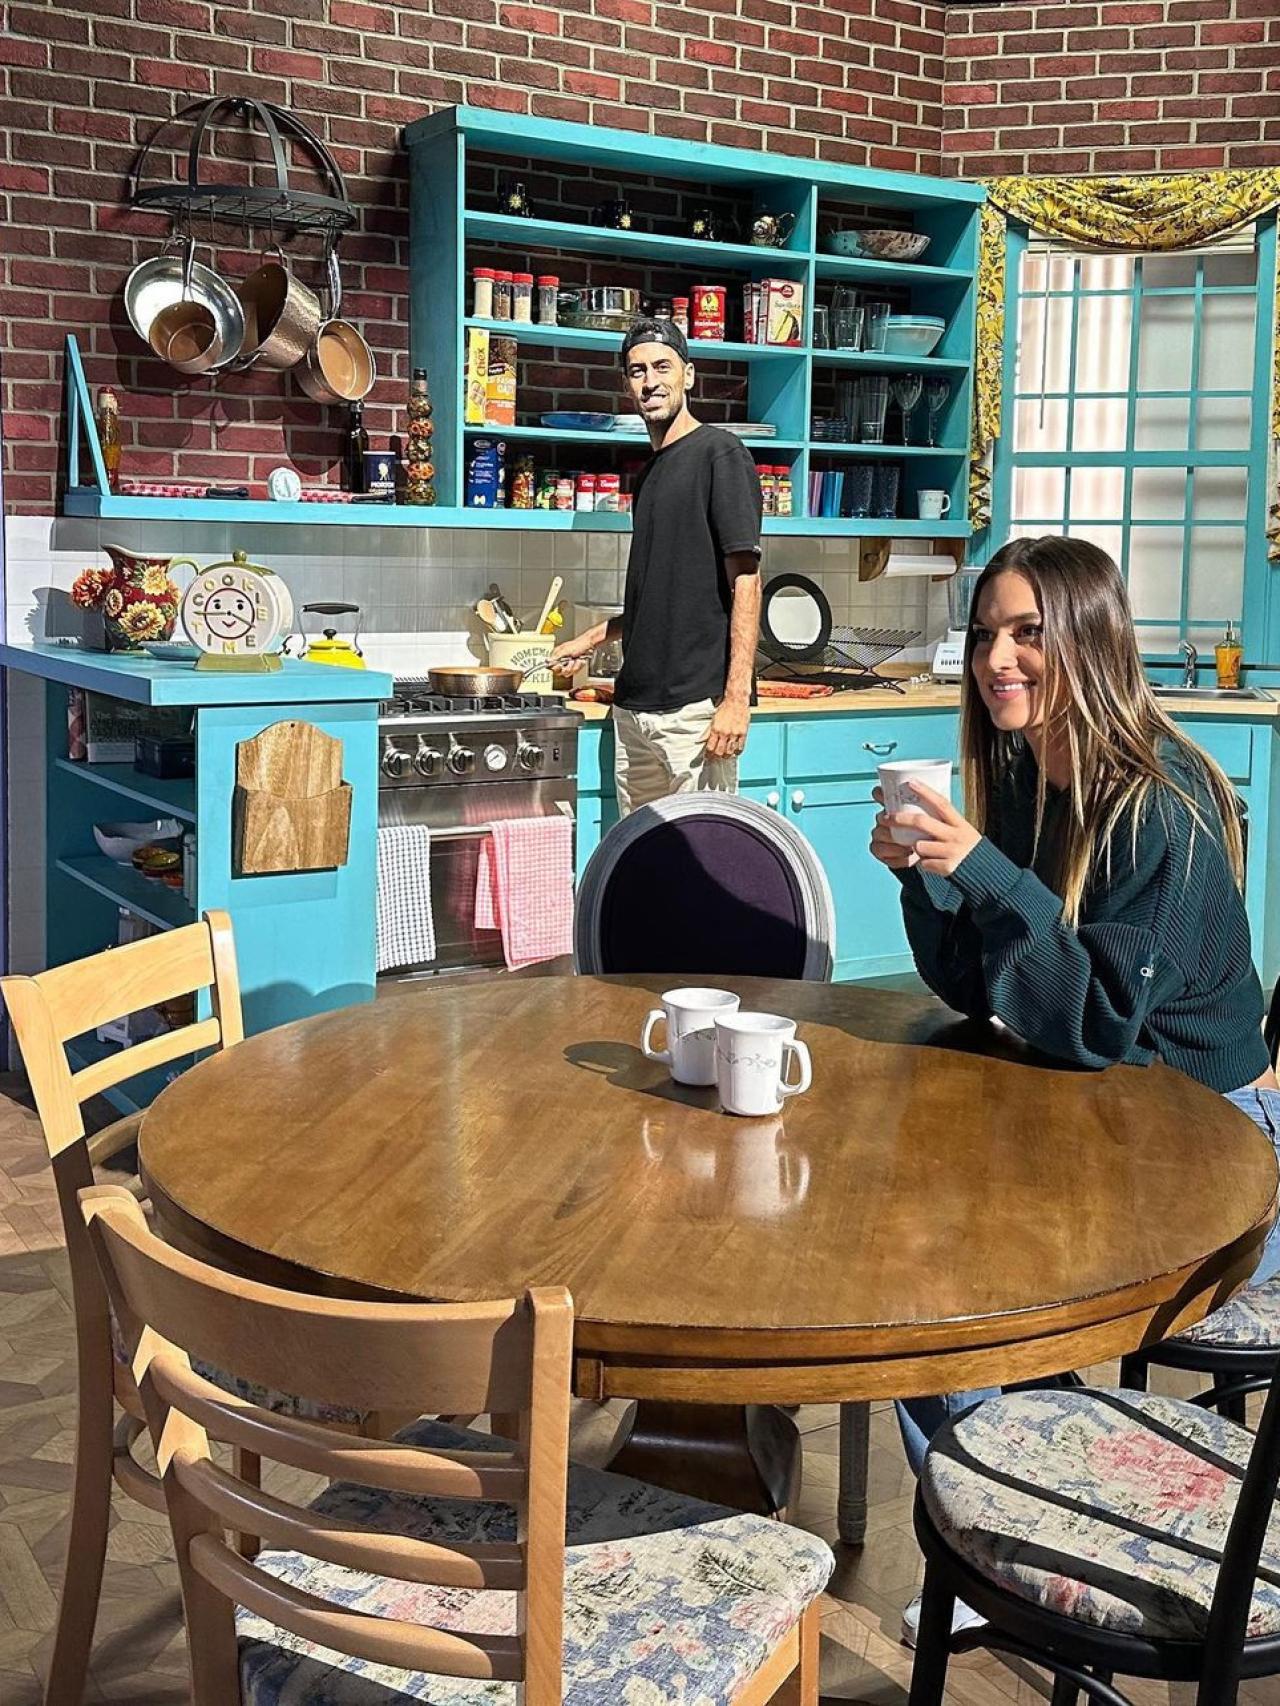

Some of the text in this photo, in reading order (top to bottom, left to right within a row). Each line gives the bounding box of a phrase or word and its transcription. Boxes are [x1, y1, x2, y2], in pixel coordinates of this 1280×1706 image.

[476, 347, 486, 377] Chex
[192, 574, 268, 621] COOKIE
[190, 620, 256, 653] TIME
